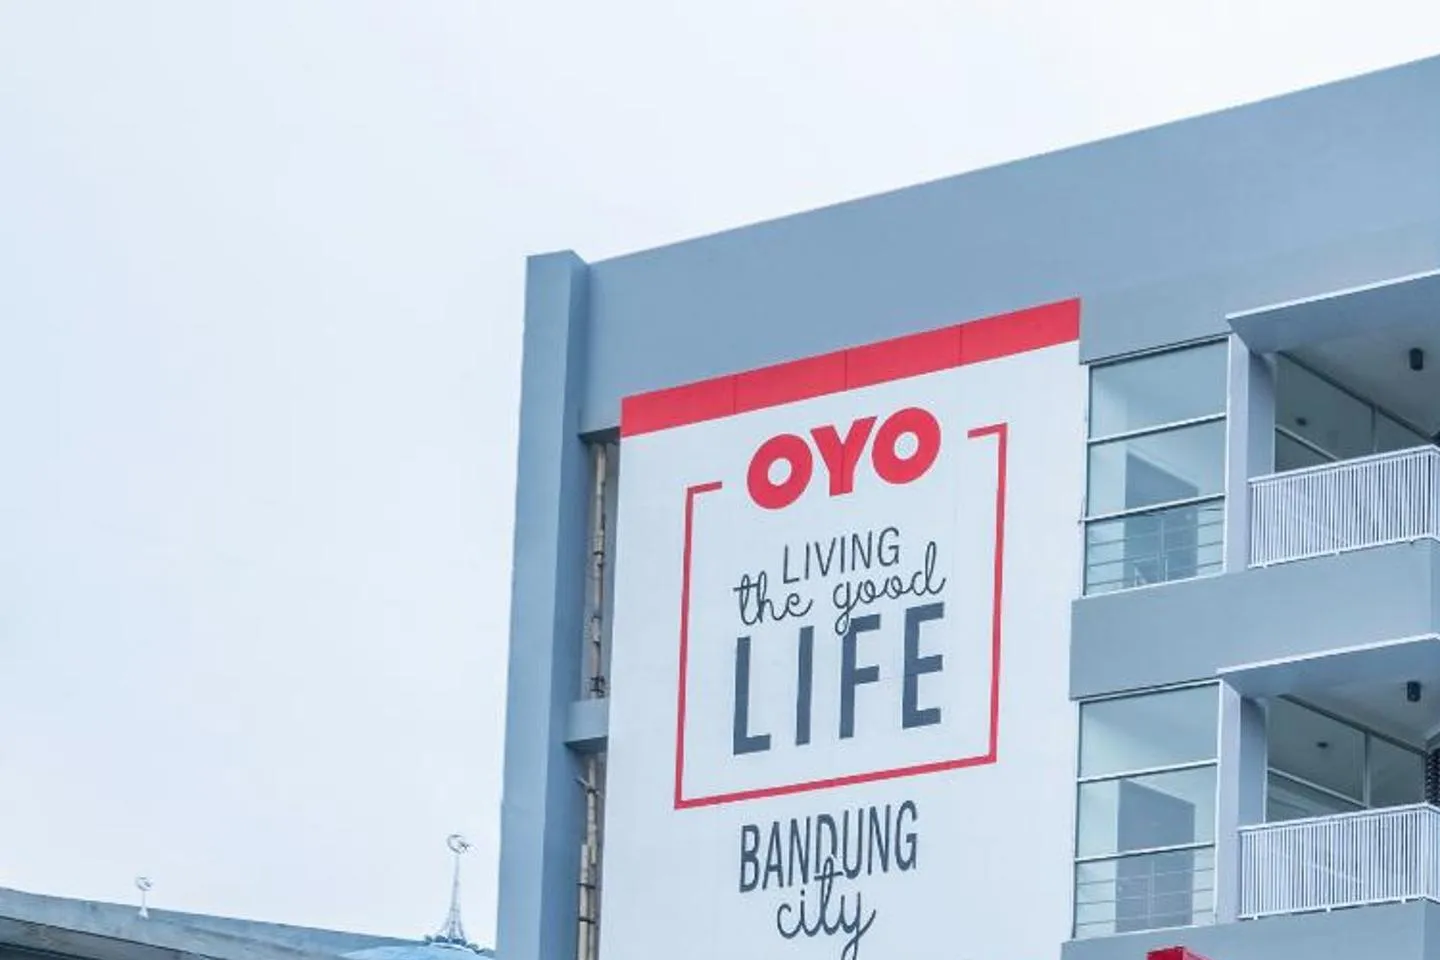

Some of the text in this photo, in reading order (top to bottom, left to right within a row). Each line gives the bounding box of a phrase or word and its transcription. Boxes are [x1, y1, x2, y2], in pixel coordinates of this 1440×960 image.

[747, 407, 941, 509] OYO
[733, 541, 946, 635] the good
[783, 527, 901, 584] LIVING
[733, 602, 944, 755] LIFE
[739, 800, 918, 893] BANDUNG
